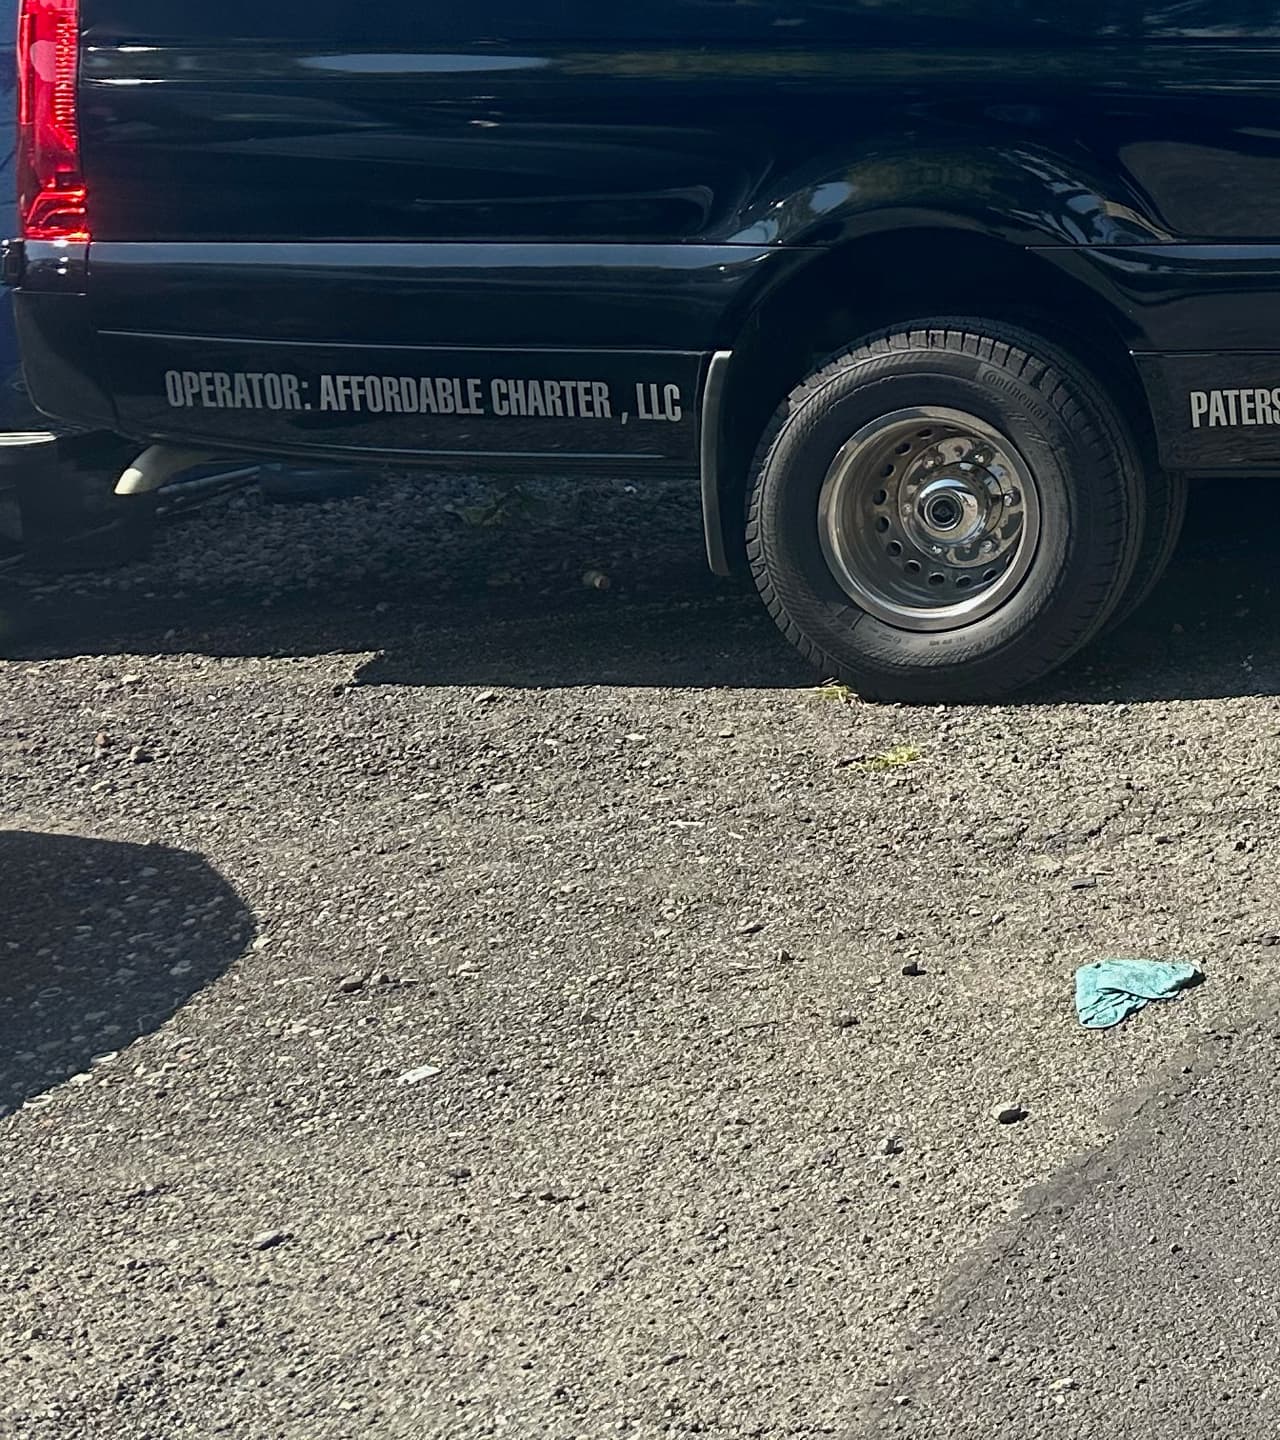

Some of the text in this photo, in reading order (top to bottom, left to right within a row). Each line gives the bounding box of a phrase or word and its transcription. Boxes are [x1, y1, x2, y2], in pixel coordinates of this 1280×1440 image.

[165, 370, 311, 410] OPERATOR:
[320, 375, 484, 414] AFFORDABLE
[491, 378, 612, 418] CHARTER
